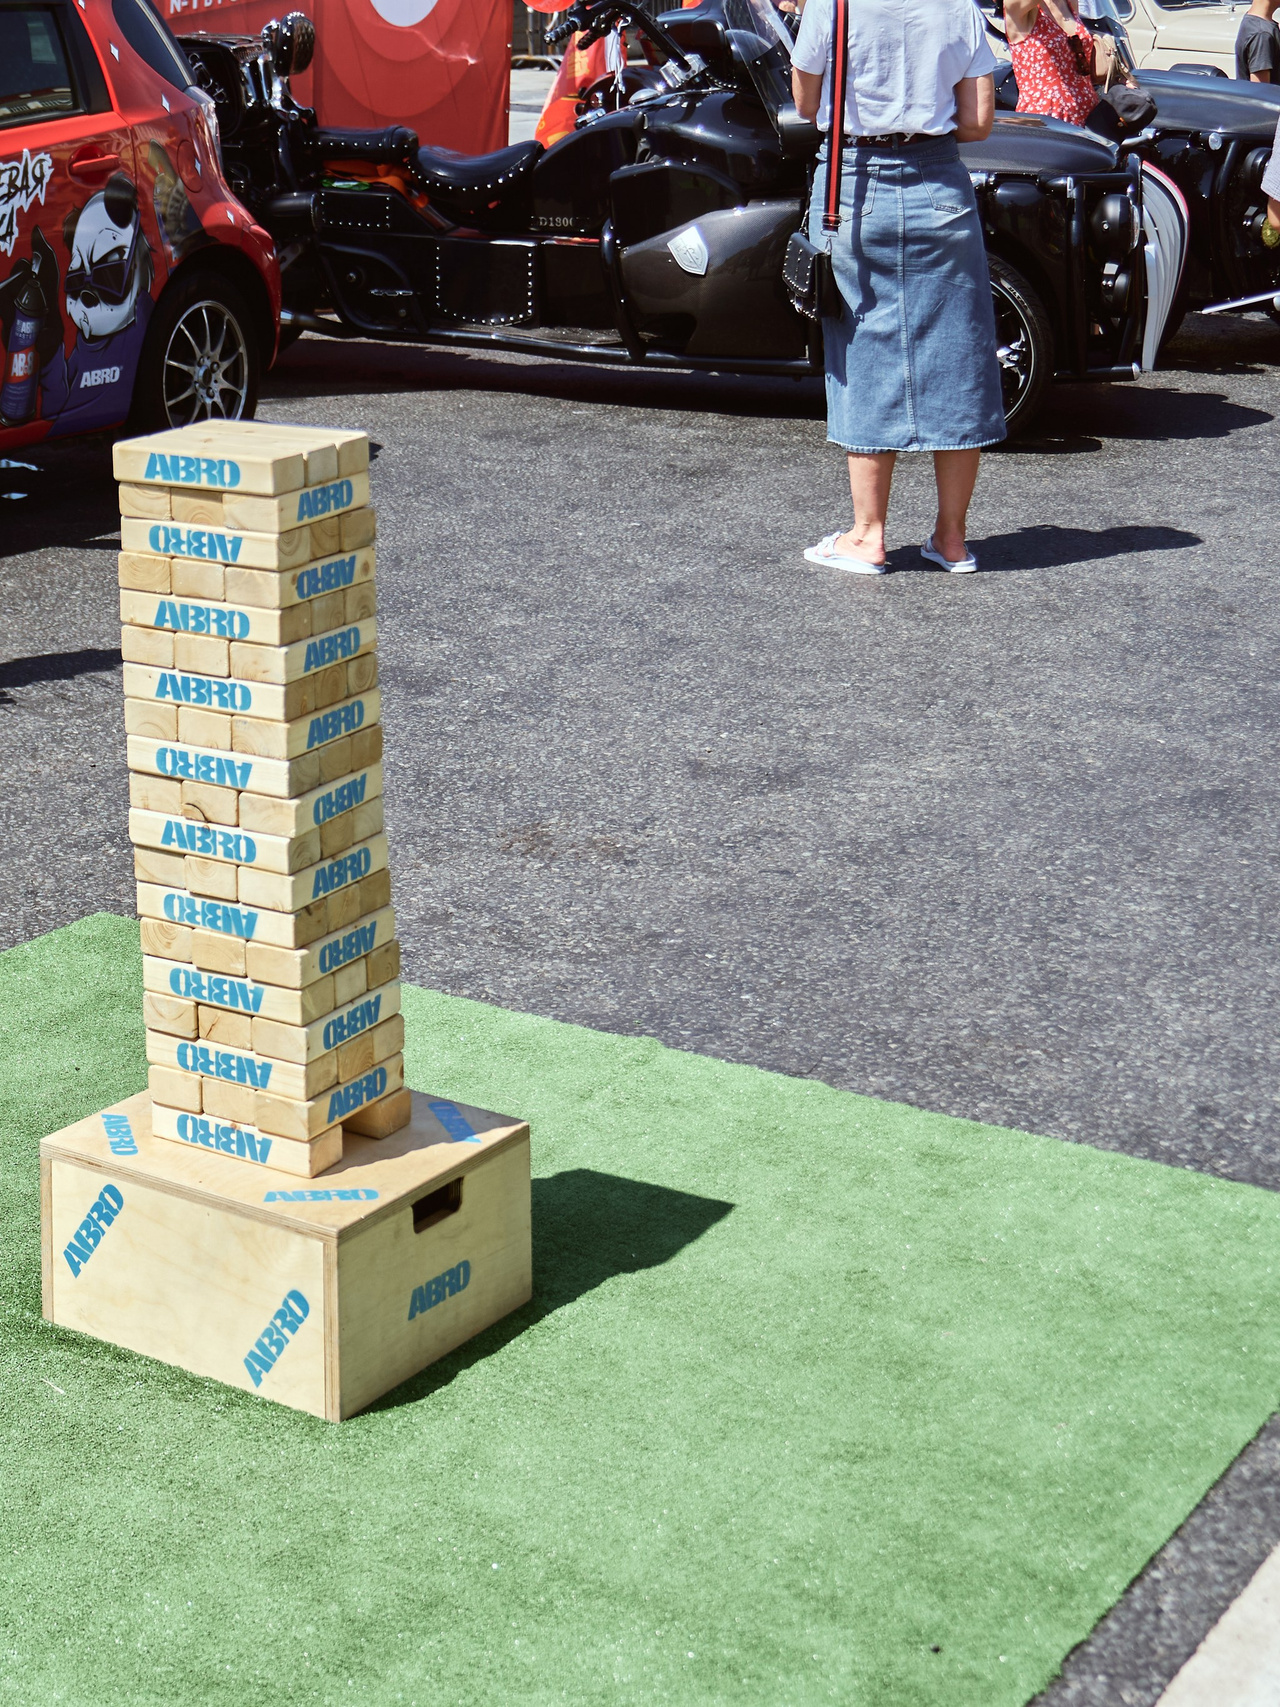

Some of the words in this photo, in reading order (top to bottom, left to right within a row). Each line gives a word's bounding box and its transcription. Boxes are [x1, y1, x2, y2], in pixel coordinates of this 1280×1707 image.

[80, 366, 120, 389] ABRO
[144, 452, 241, 488] ABRO
[297, 479, 353, 522] ABRO
[148, 525, 243, 563] ABRO
[296, 555, 356, 600] ABRO
[154, 600, 250, 640] ABRO
[303, 626, 360, 673] ABRO
[155, 673, 252, 711] ABRO
[307, 700, 364, 749] ABRO
[156, 747, 253, 789] ABRO
[313, 773, 367, 826] ABRO
[161, 820, 257, 864] ABRO
[312, 847, 371, 899] ABRO
[163, 893, 258, 940] ABRO
[319, 921, 377, 974] ABRO
[169, 967, 264, 1013] ABRO
[323, 993, 381, 1050] ABRO
[176, 1042, 273, 1089] ABRO
[327, 1066, 387, 1124] ABRO
[101, 1113, 139, 1156] ABRO
[176, 1114, 273, 1164] ABRO
[428, 1101, 482, 1143] ABRO
[263, 1188, 380, 1203] ABRO
[63, 1183, 124, 1279] ABRO
[408, 1260, 471, 1321] ABRO
[242, 1289, 311, 1388] ABRO
